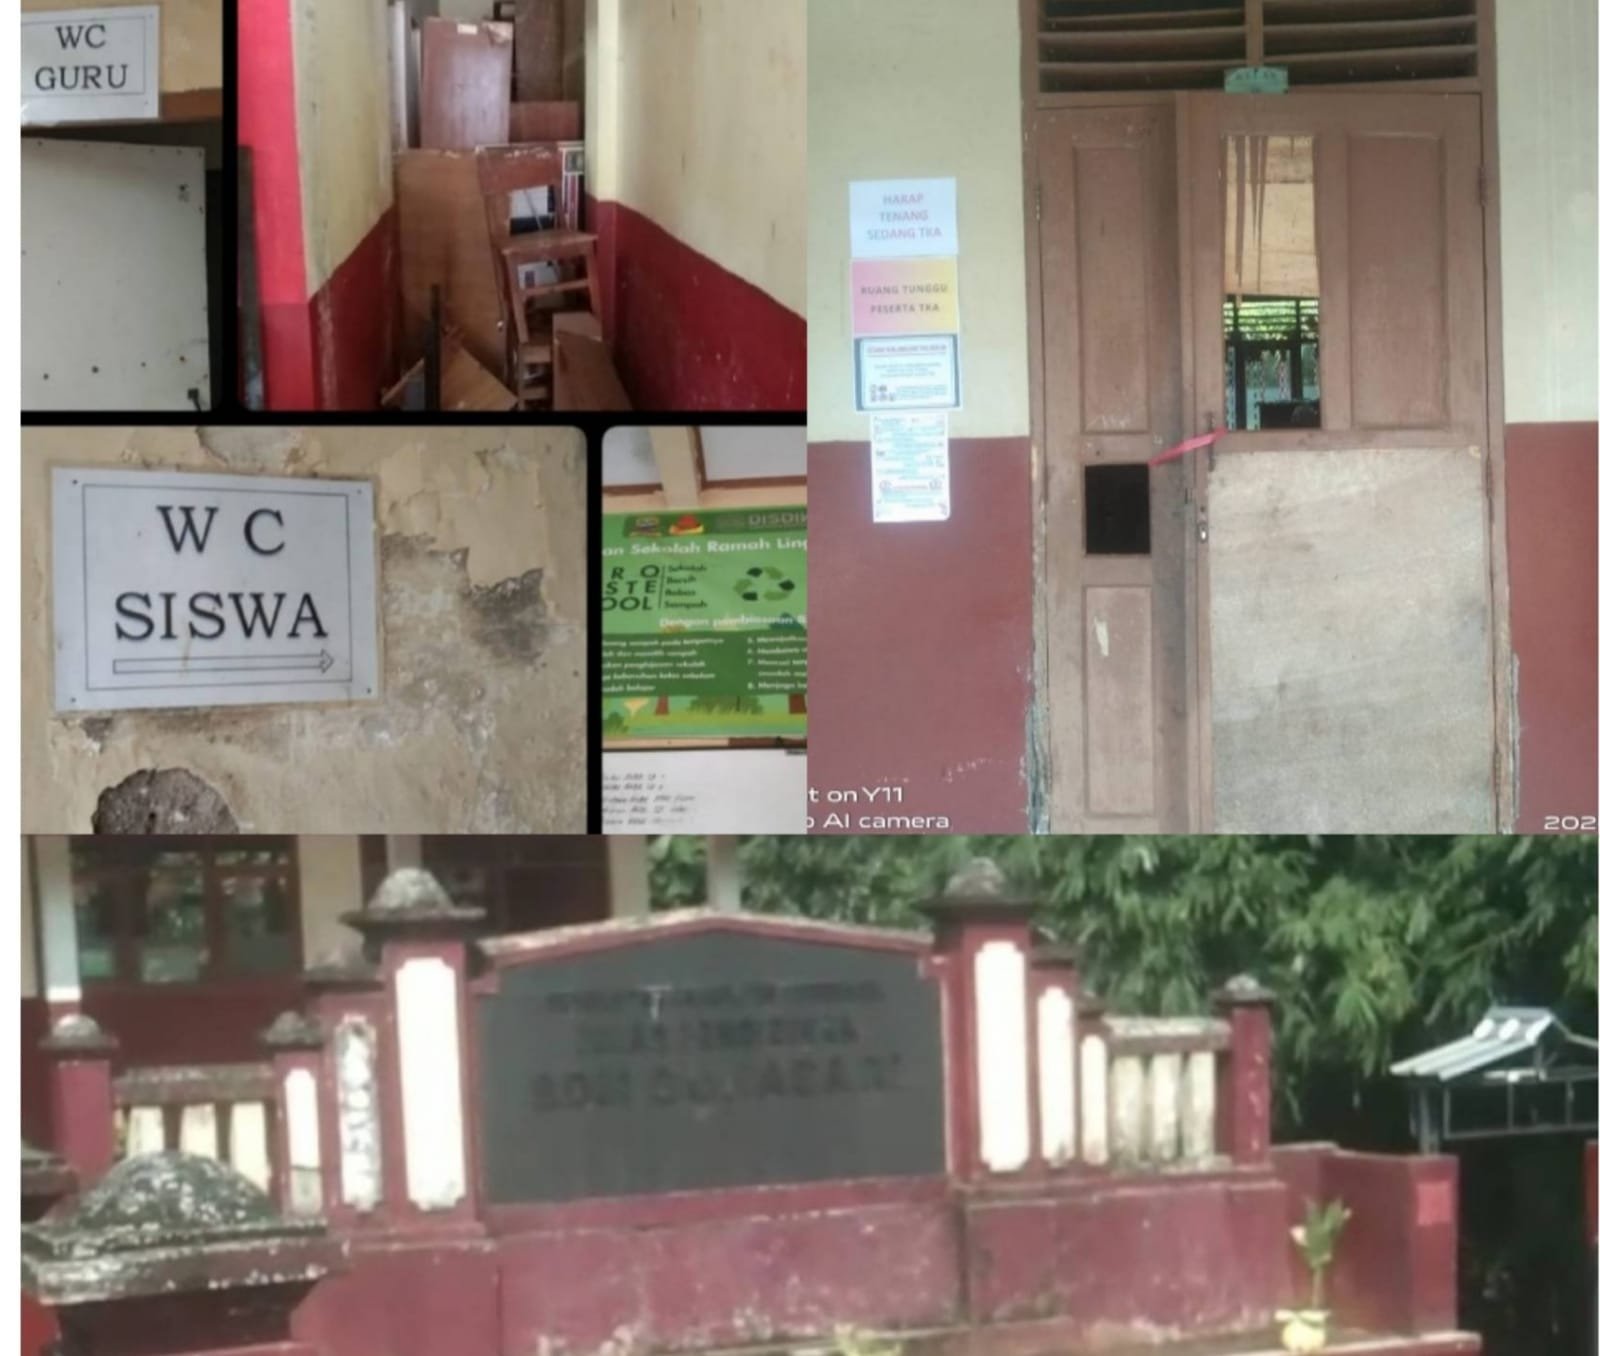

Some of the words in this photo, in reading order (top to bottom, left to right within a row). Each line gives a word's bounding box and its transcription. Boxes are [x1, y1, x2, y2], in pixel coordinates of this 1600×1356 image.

[56, 25, 106, 49] WC
[35, 64, 128, 90] GURU
[883, 193, 924, 205] HARAP
[880, 210, 929, 222] TENANG
[866, 228, 916, 240] SEDANG
[919, 227, 942, 238] TKA
[861, 285, 899, 295] RUANG
[902, 283, 948, 294] TUNGGU
[871, 304, 915, 314] PESERTA
[918, 303, 940, 312] TKA
[631, 542, 700, 555] Sekolah
[707, 538, 770, 553] Ramah
[114, 591, 328, 641] SISWA
